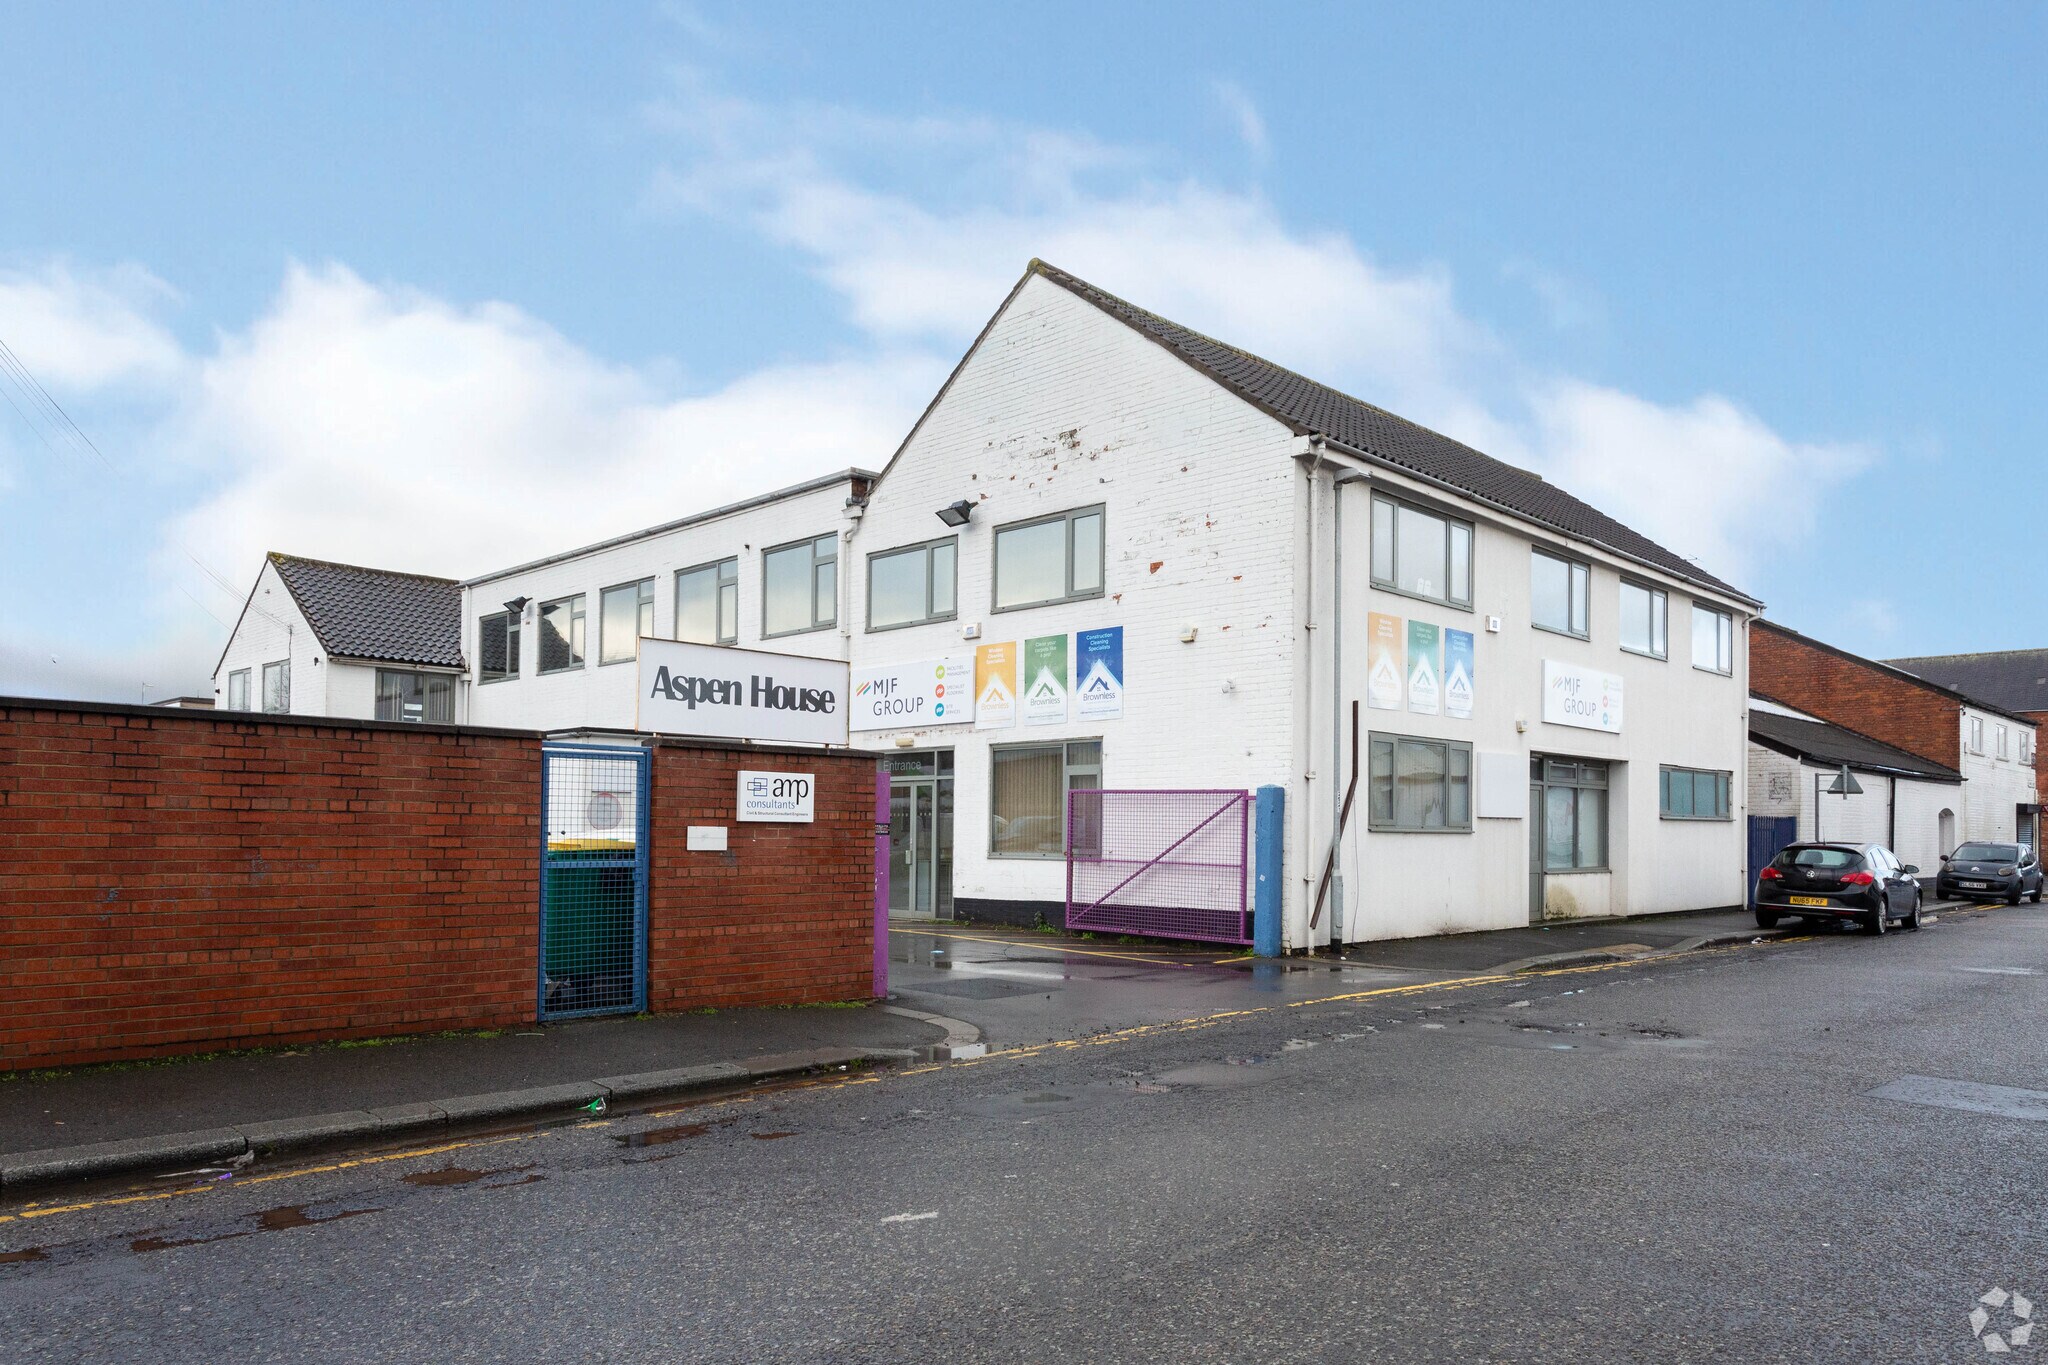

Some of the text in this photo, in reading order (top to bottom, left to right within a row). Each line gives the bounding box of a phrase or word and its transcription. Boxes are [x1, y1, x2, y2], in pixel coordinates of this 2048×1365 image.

[1085, 632, 1113, 641] Construction
[1089, 639, 1109, 647] Cleaning
[650, 665, 836, 714] Aspen House
[873, 677, 898, 698] MJF
[1564, 676, 1581, 696] MJF
[1030, 696, 1061, 706] Brownless
[1083, 692, 1116, 702] Brownless
[873, 696, 924, 716] GROUP
[981, 702, 1009, 711] Brownless
[1564, 698, 1597, 717] GROUP
[883, 760, 922, 772] Entrance
[772, 778, 809, 806] amp
[746, 799, 796, 810] consultants
